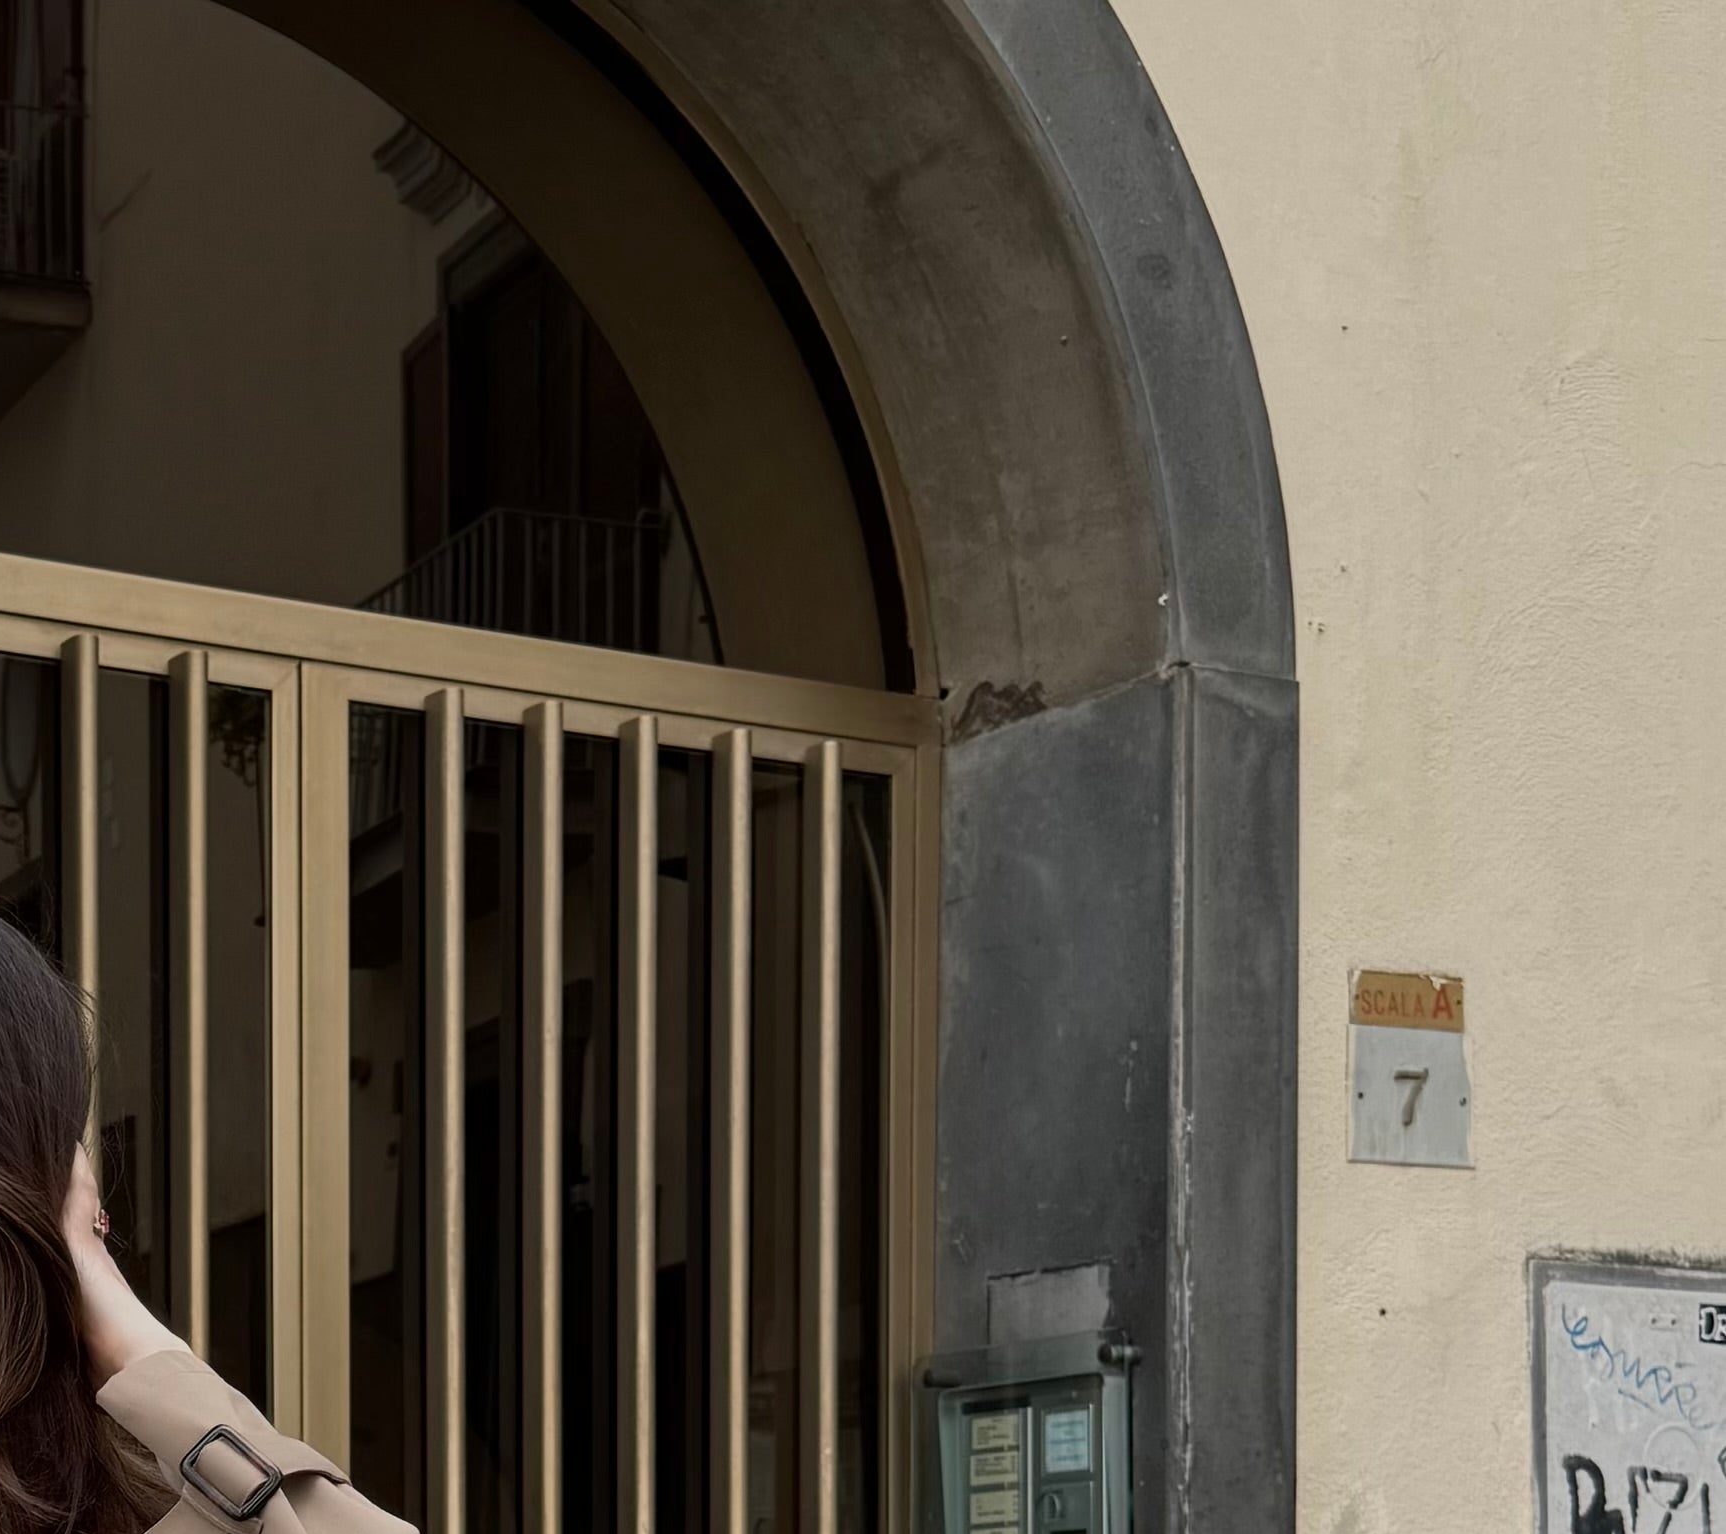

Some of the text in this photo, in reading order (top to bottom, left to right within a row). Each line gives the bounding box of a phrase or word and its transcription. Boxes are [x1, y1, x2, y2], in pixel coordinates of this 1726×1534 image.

[1360, 984, 1454, 1020] SCALA A
[1393, 1067, 1430, 1127] 7
